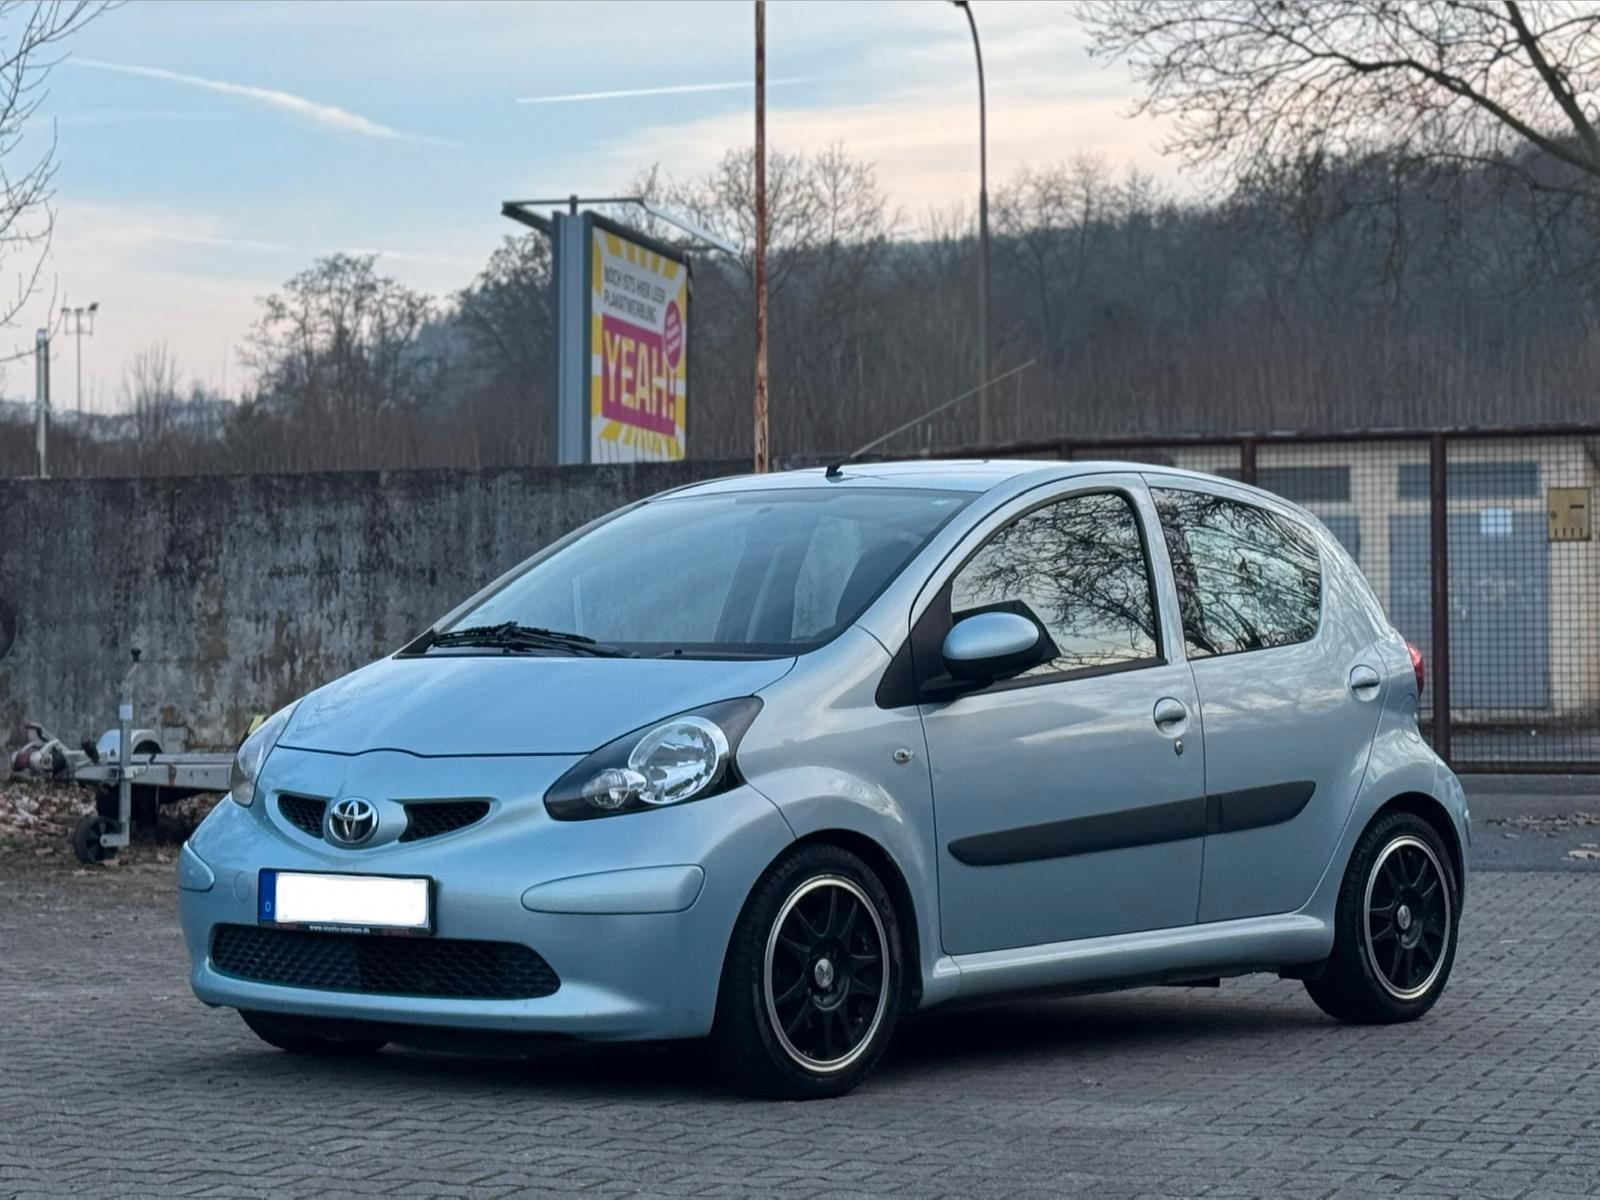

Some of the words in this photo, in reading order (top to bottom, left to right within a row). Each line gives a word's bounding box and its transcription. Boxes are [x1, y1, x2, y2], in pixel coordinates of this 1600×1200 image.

[605, 266, 621, 287] NOCH
[604, 330, 675, 420] YEAH!
[264, 901, 272, 912] D
